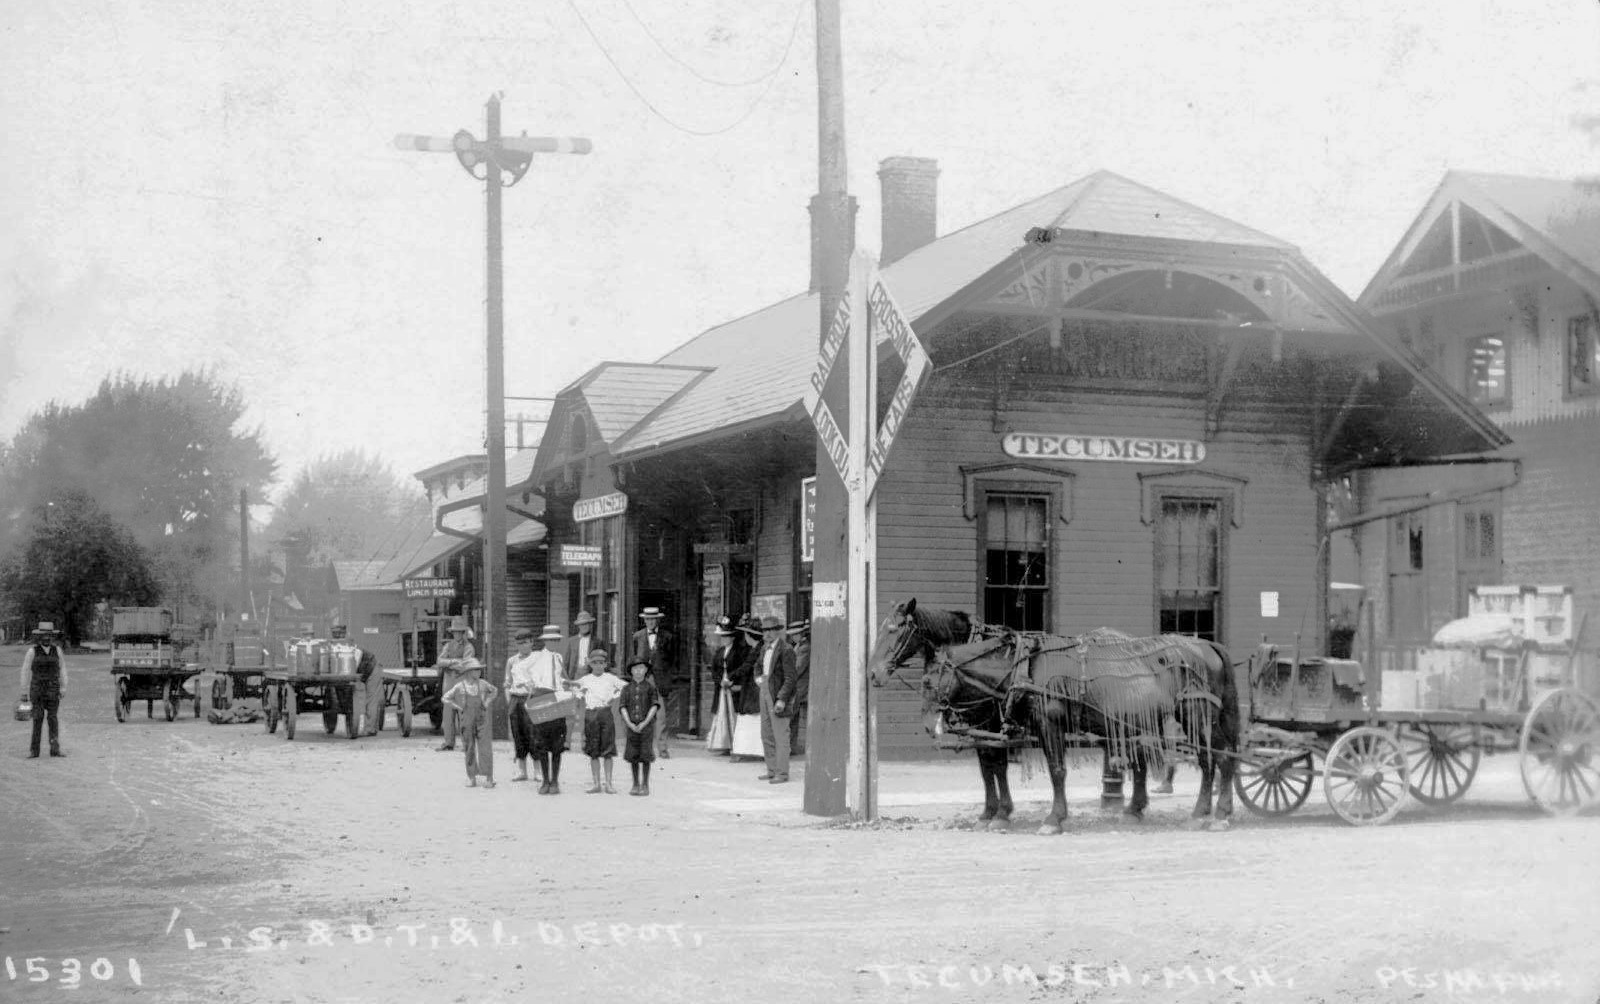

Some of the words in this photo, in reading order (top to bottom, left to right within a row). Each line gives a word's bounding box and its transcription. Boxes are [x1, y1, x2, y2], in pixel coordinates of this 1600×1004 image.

[885, 375, 914, 438] CARS
[1012, 435, 1198, 460] TECUMSEH
[562, 551, 601, 560] TELEGRAPH
[405, 579, 455, 588] RESTAURANT
[433, 588, 455, 597] ROOM
